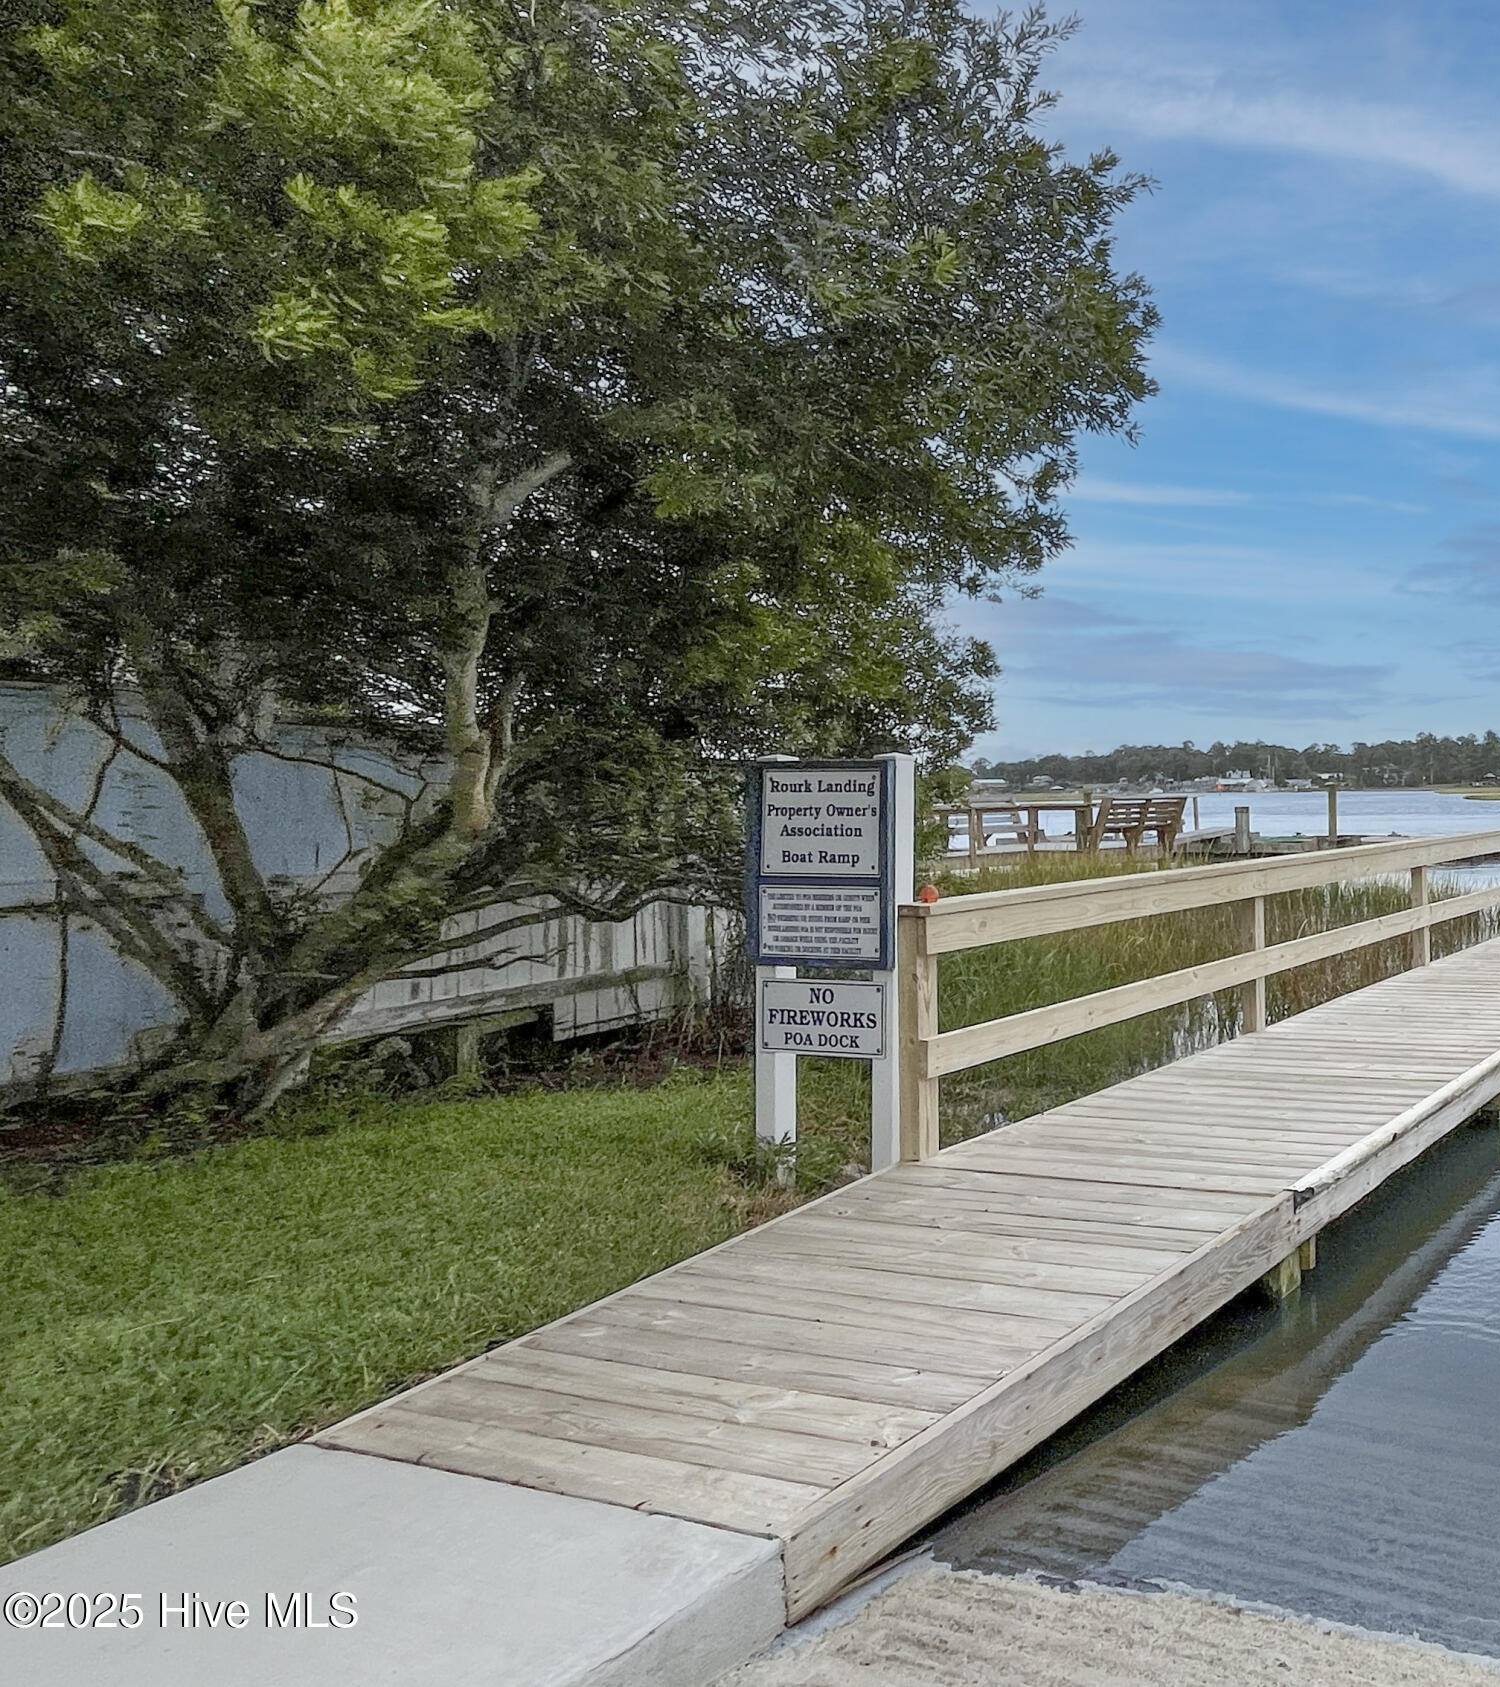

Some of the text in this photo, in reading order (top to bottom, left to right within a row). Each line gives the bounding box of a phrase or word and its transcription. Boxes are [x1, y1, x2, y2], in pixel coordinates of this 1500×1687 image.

[769, 779, 875, 797] Rourk Landing
[767, 804, 877, 820] Property Owner's
[780, 824, 863, 837] Association
[781, 850, 860, 867] Boat Ramp
[809, 987, 834, 1004] NO
[768, 1008, 877, 1029] FIREWORKS
[784, 1032, 860, 1048] POA DOCK
